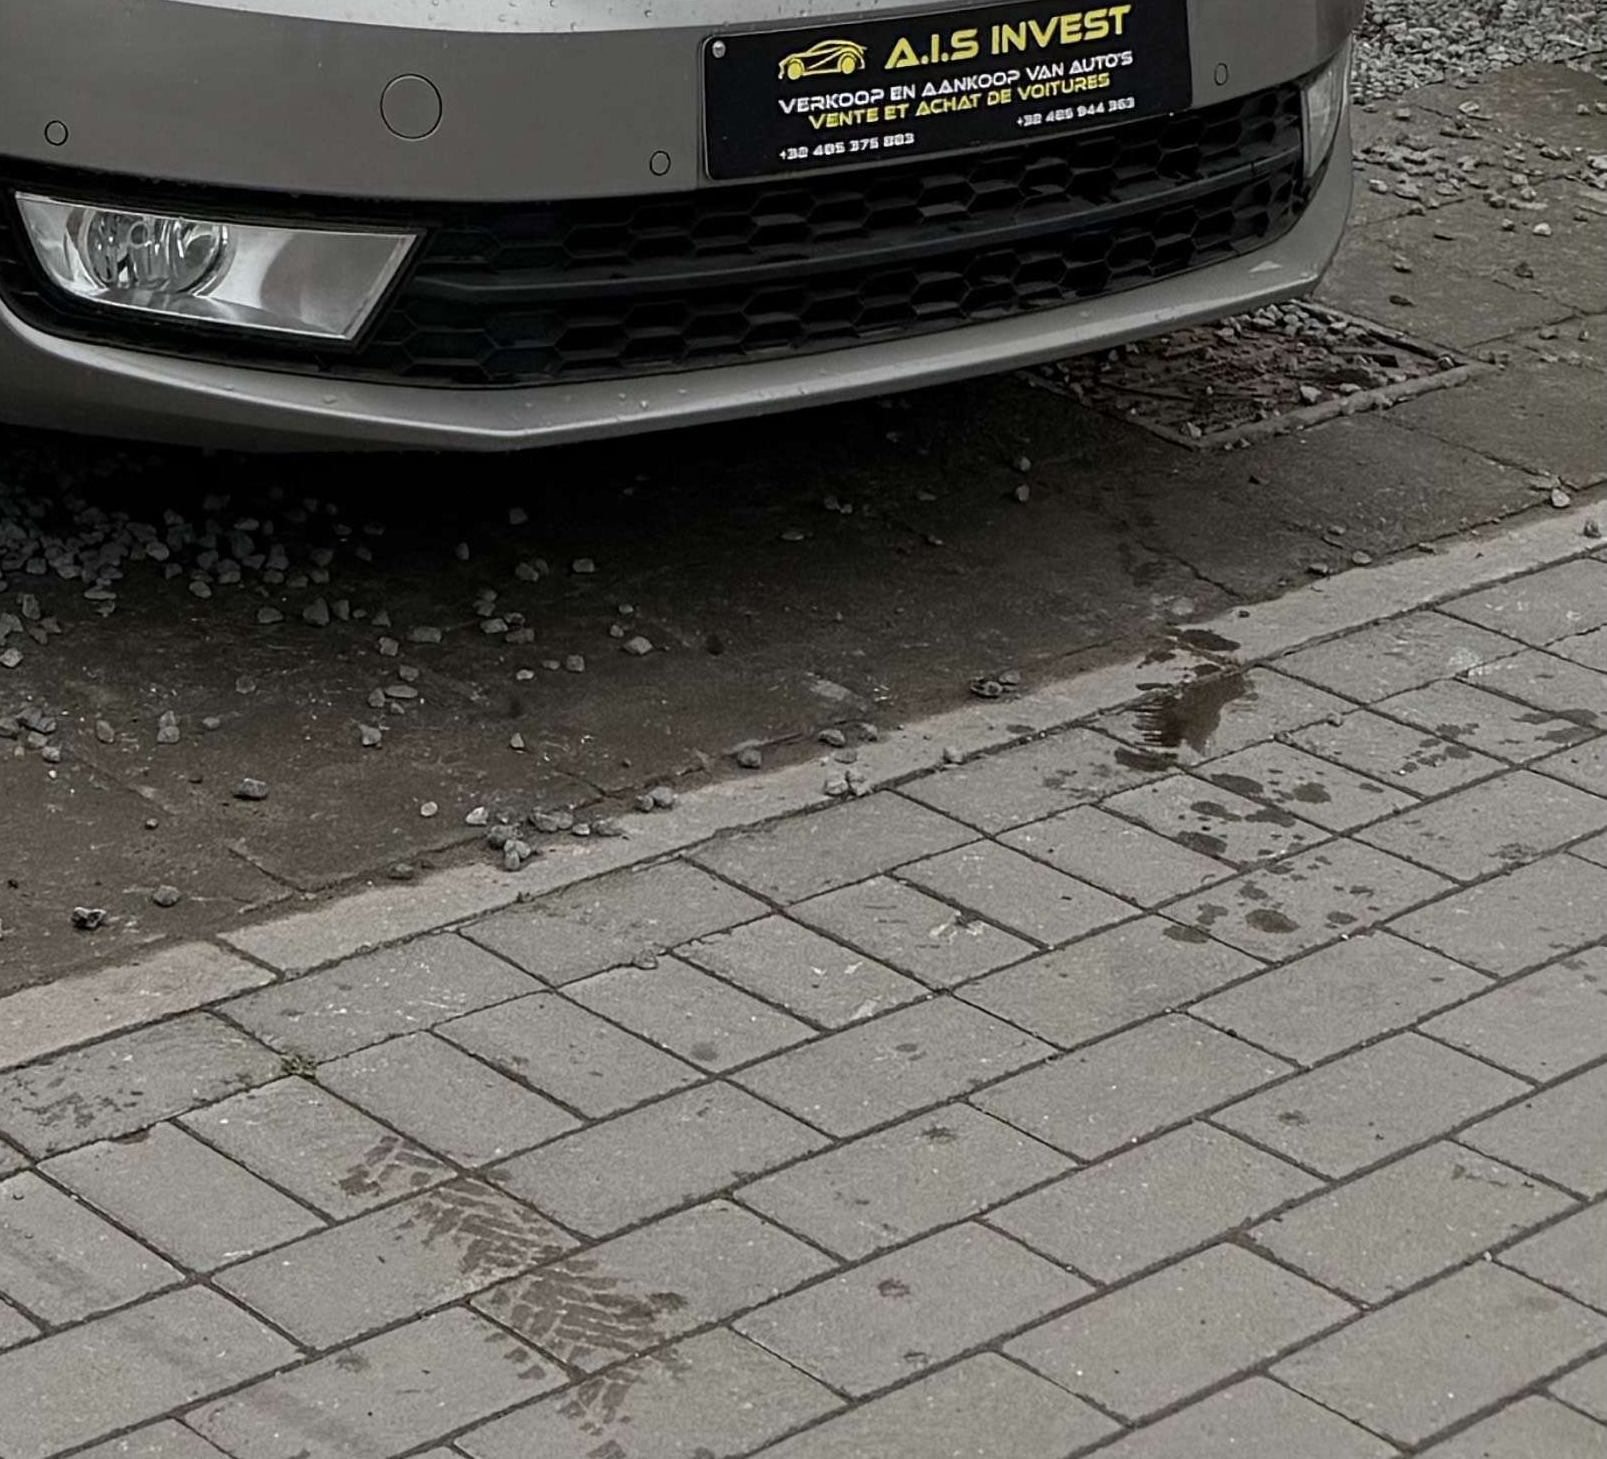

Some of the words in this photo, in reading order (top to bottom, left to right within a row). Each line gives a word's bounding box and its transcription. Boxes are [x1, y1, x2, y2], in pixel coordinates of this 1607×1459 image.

[884, 28, 979, 70] A.I.S
[991, 4, 1132, 55] INVEST
[778, 88, 885, 114] VERKOOP
[890, 83, 916, 102] EN
[921, 70, 1021, 97] AANKOOP
[1026, 64, 1065, 82] VAN
[1068, 50, 1134, 76] AUTO'S
[808, 108, 880, 130] VENTE
[884, 103, 910, 121] ET
[915, 93, 982, 117] ACHAT
[987, 88, 1012, 106] DE
[1017, 72, 1112, 101] VOITURES
